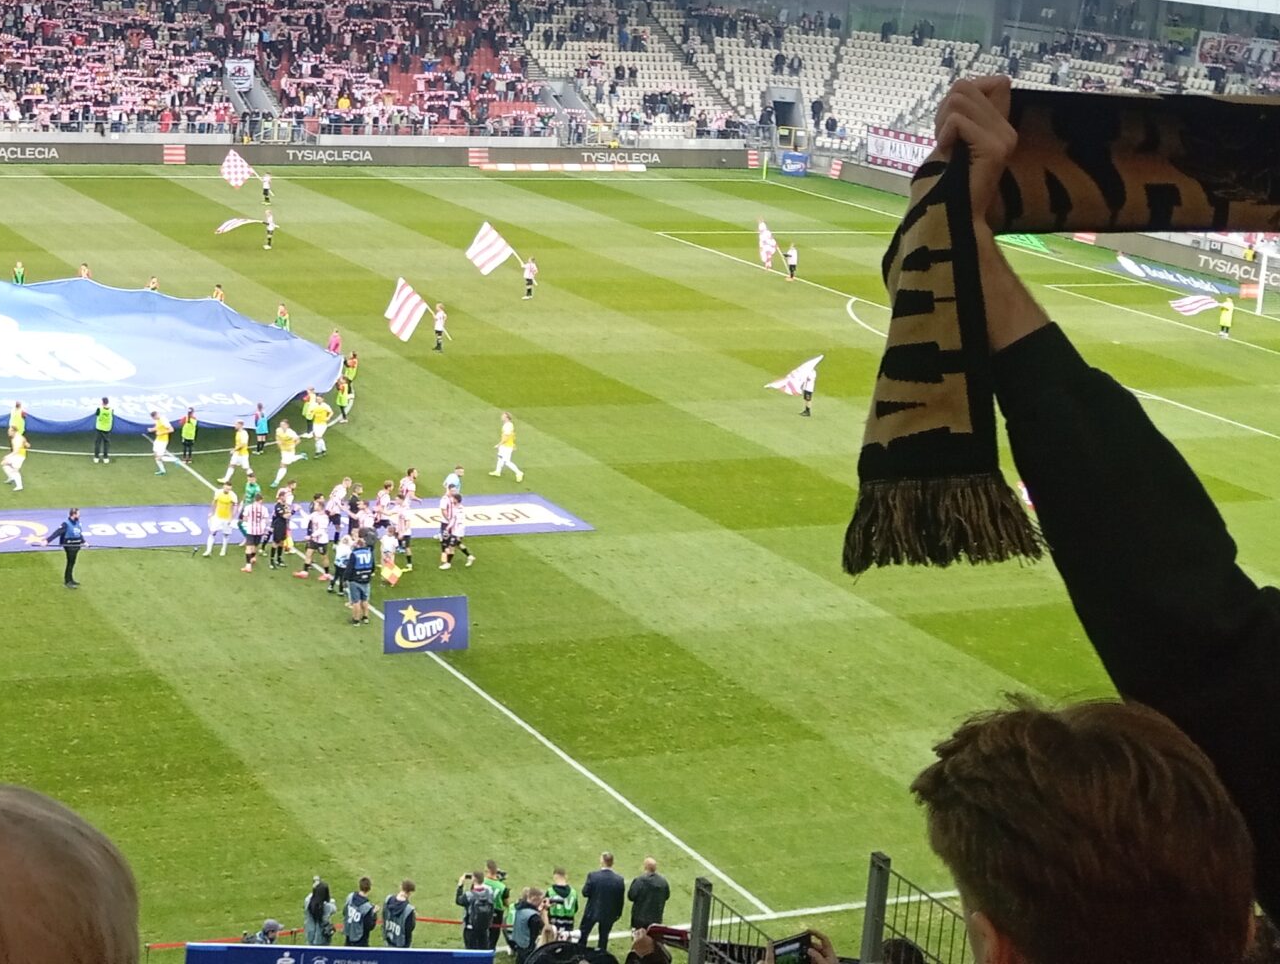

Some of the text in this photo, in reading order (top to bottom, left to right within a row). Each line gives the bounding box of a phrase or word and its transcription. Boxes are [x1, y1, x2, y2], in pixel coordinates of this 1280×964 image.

[286, 149, 373, 164] TYSIĄCLECIA
[581, 152, 661, 165] TYSIĄCLECIA
[407, 617, 444, 641] LOTTO
